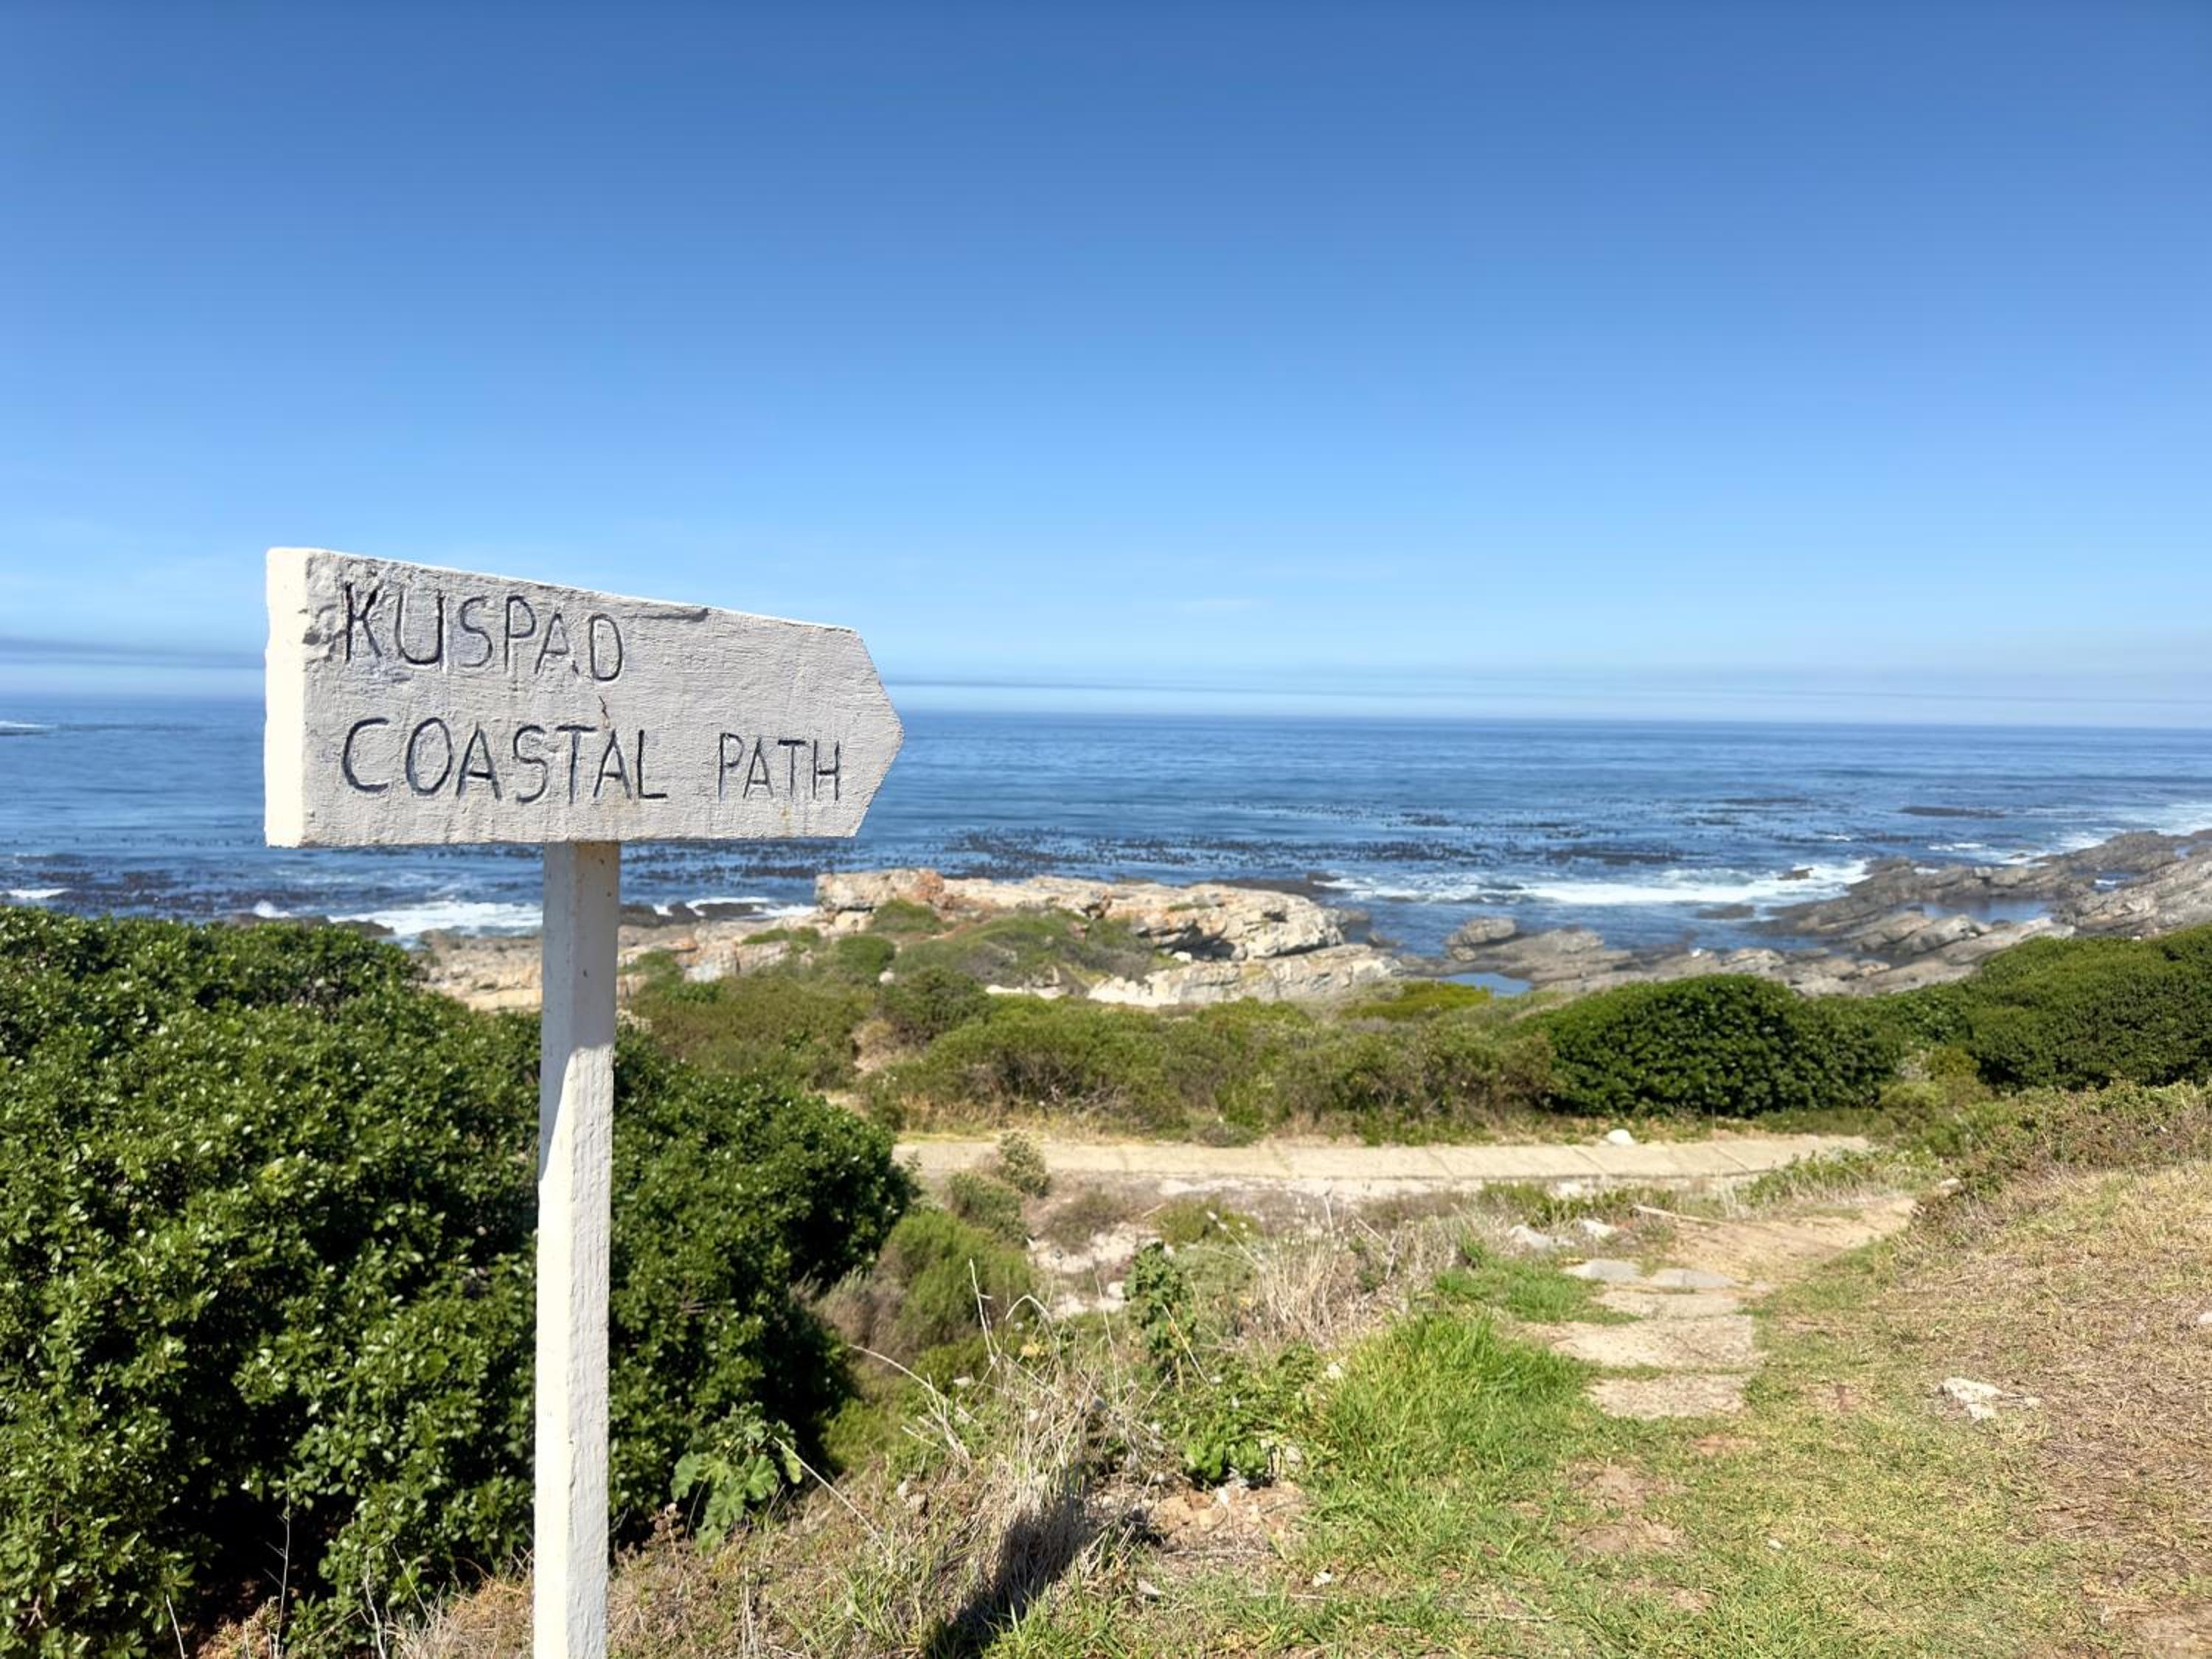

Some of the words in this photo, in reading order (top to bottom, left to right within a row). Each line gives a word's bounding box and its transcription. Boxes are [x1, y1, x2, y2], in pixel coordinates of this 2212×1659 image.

[344, 581, 623, 682] KUSPAD
[341, 716, 668, 804] COASTAL
[717, 731, 841, 801] PATH
